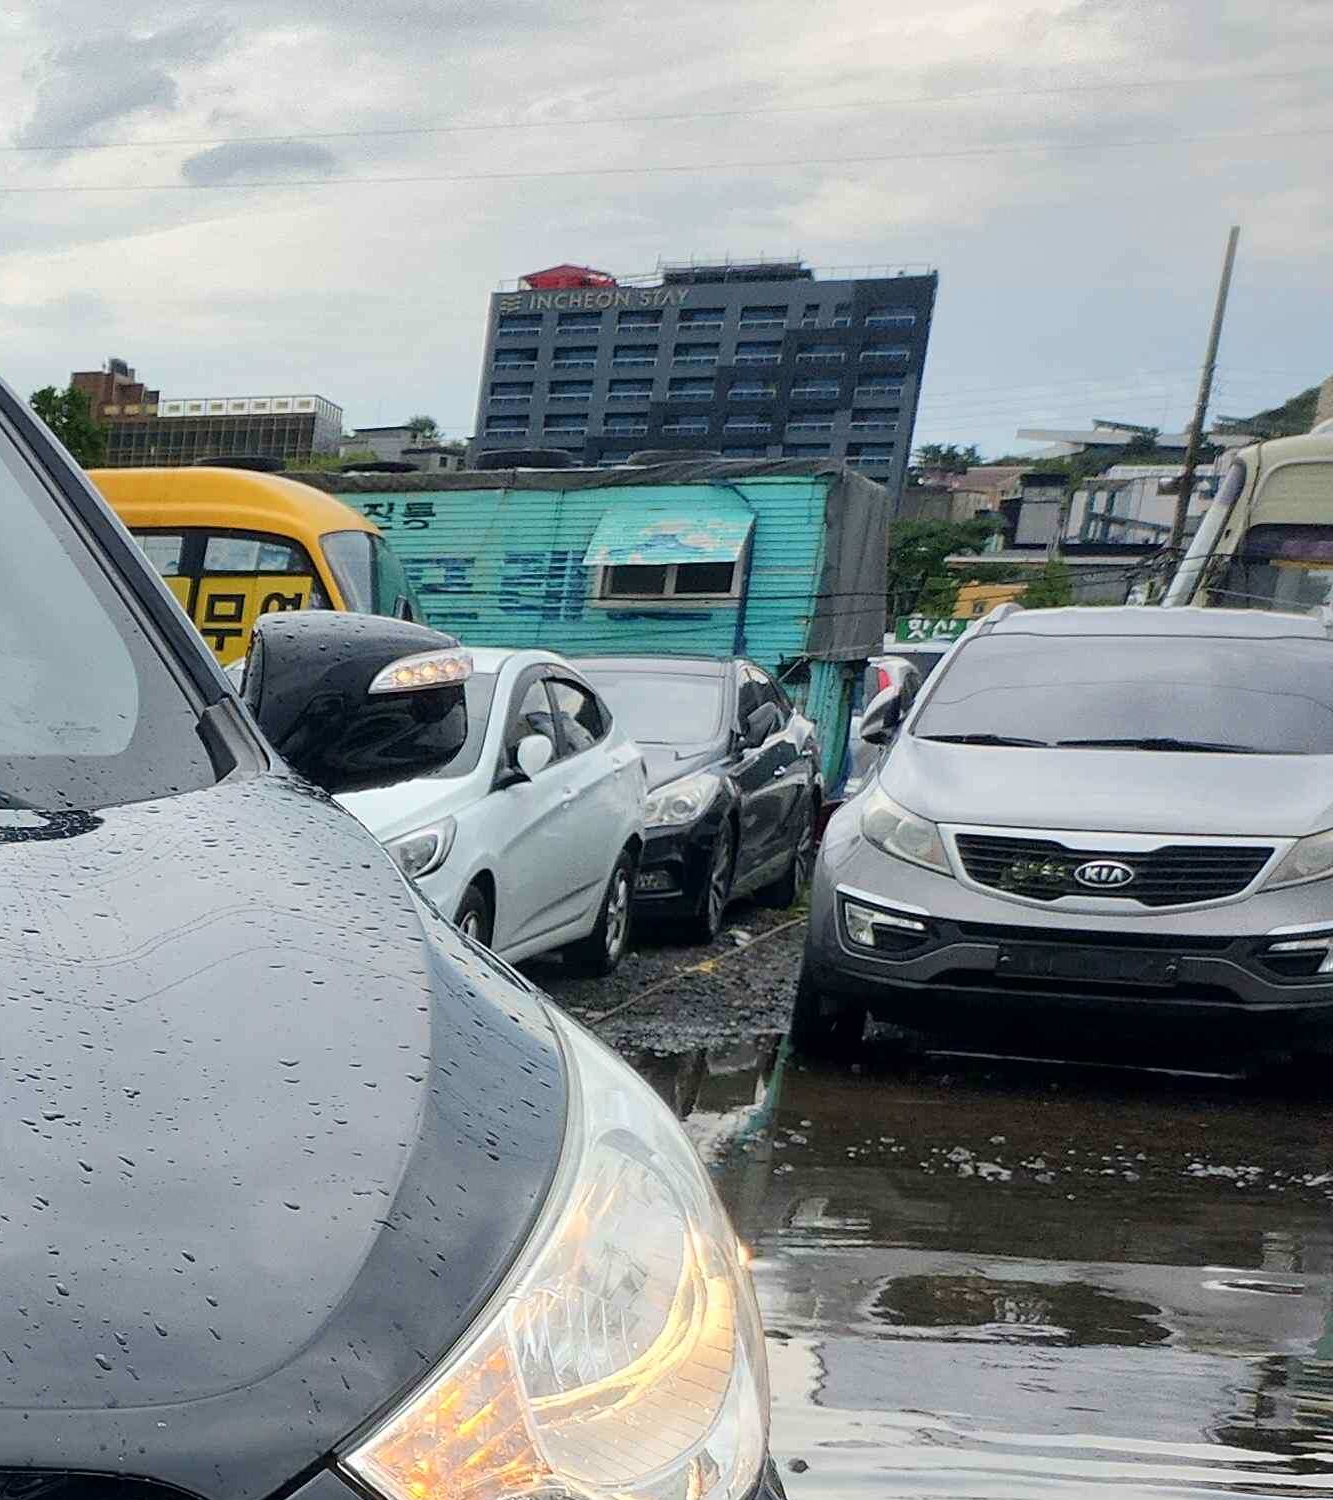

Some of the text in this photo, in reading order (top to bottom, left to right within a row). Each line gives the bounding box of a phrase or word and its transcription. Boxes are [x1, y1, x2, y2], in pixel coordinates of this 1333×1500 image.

[529, 289, 689, 310] INCHEON STAY
[1082, 865, 1126, 883] KIA
